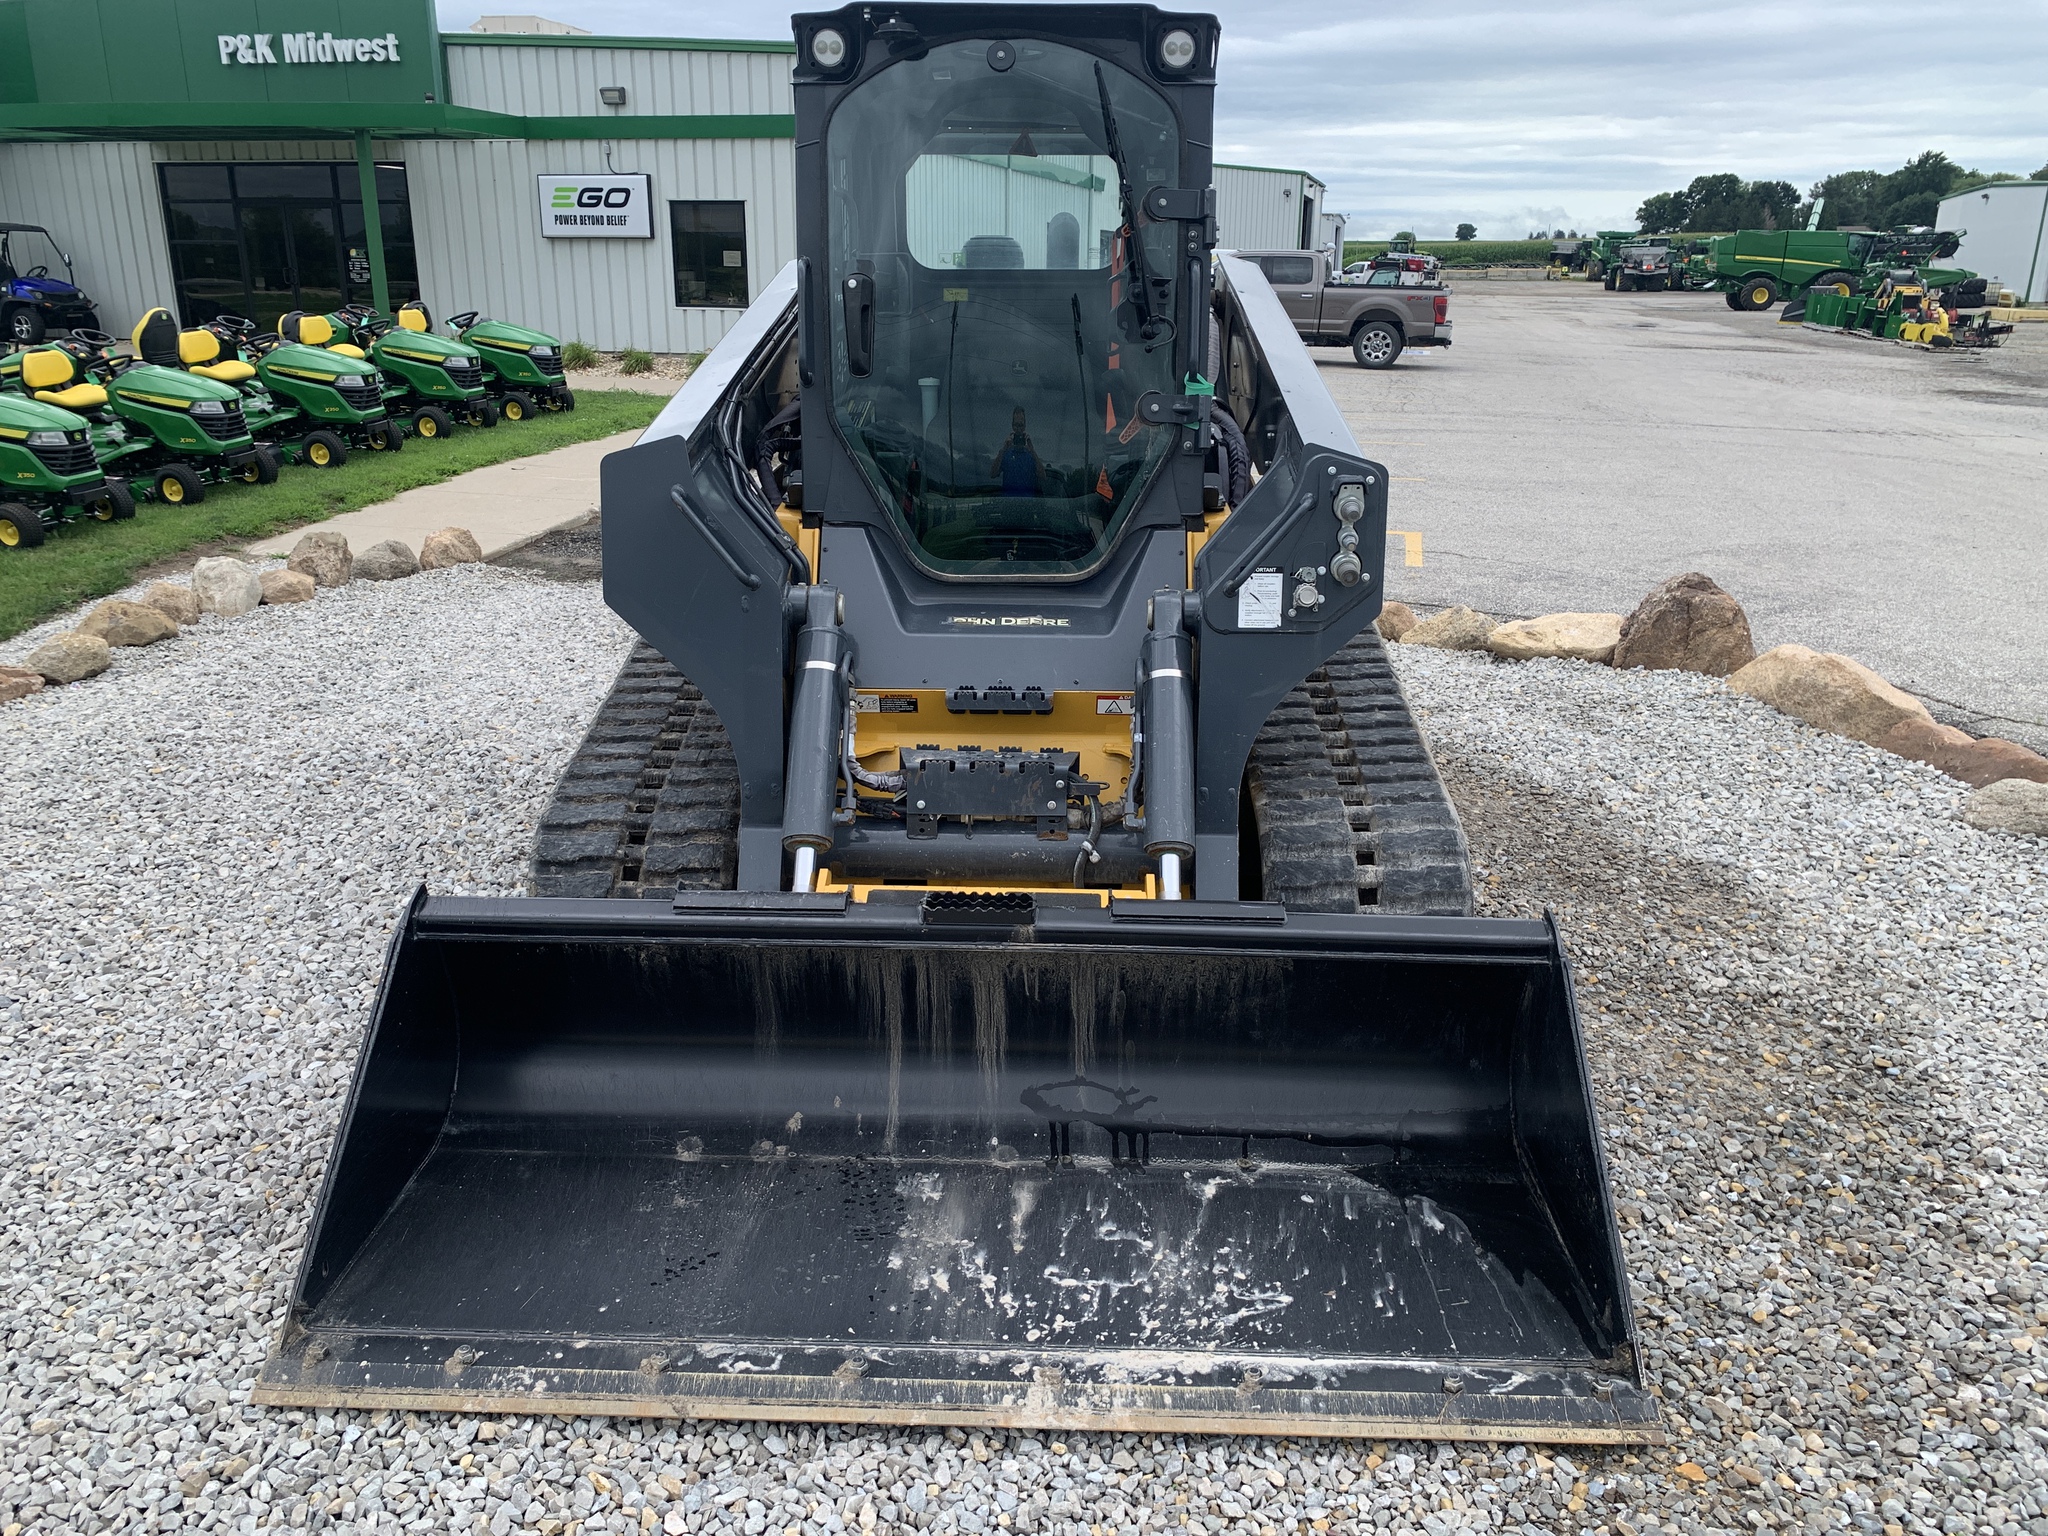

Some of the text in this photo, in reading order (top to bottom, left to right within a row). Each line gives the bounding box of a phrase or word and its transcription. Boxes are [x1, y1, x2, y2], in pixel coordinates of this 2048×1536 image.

[217, 32, 400, 64] P&K Midwest
[551, 186, 631, 208] EGO
[554, 214, 628, 226] POWER BEYOND BELIEF
[1001, 617, 1069, 626] DEERE
